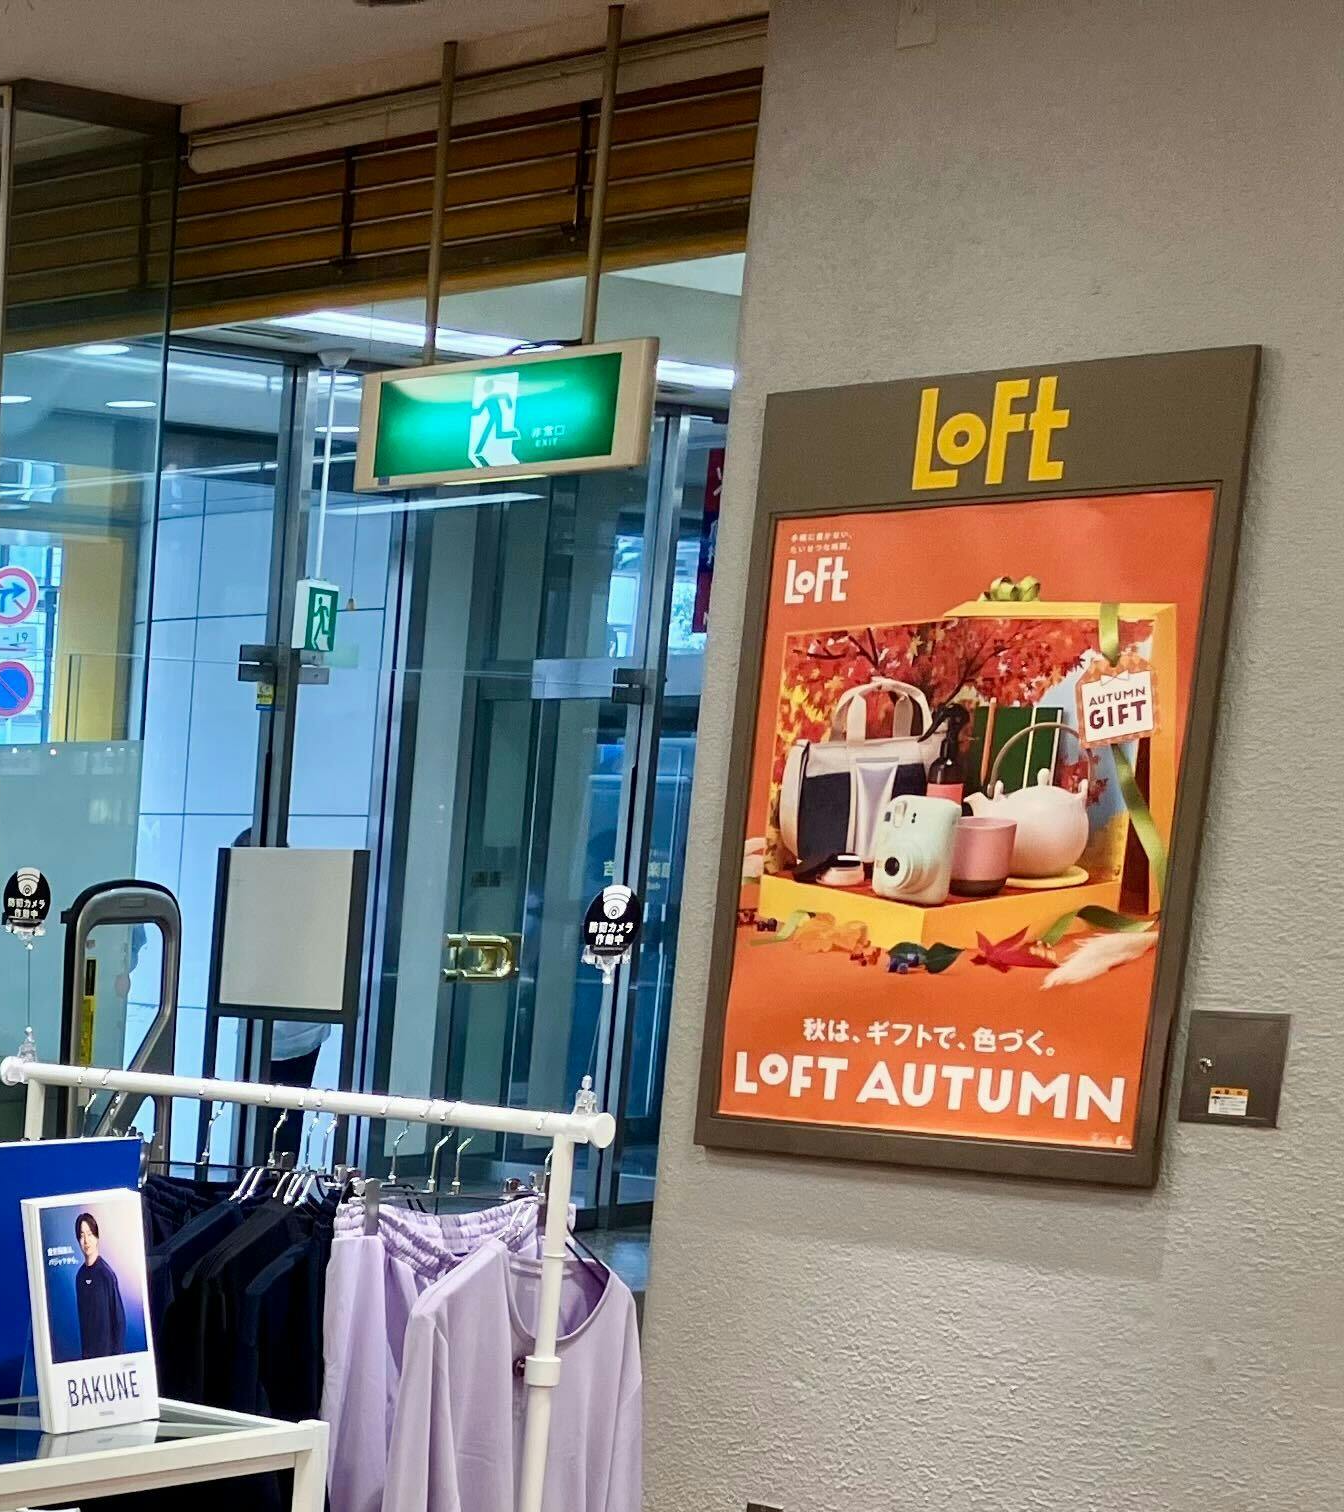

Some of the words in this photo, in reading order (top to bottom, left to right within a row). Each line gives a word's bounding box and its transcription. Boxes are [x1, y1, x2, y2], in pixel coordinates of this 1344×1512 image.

[535, 437, 559, 447] EXIT
[1089, 685, 1146, 707] AUTUMN
[1089, 699, 1147, 730] GIFT
[802, 1017, 1055, 1058] 秋は、ギフトで、色づく。
[856, 1060, 1126, 1123] AUTUMN
[67, 1369, 140, 1409] BAKUNE
